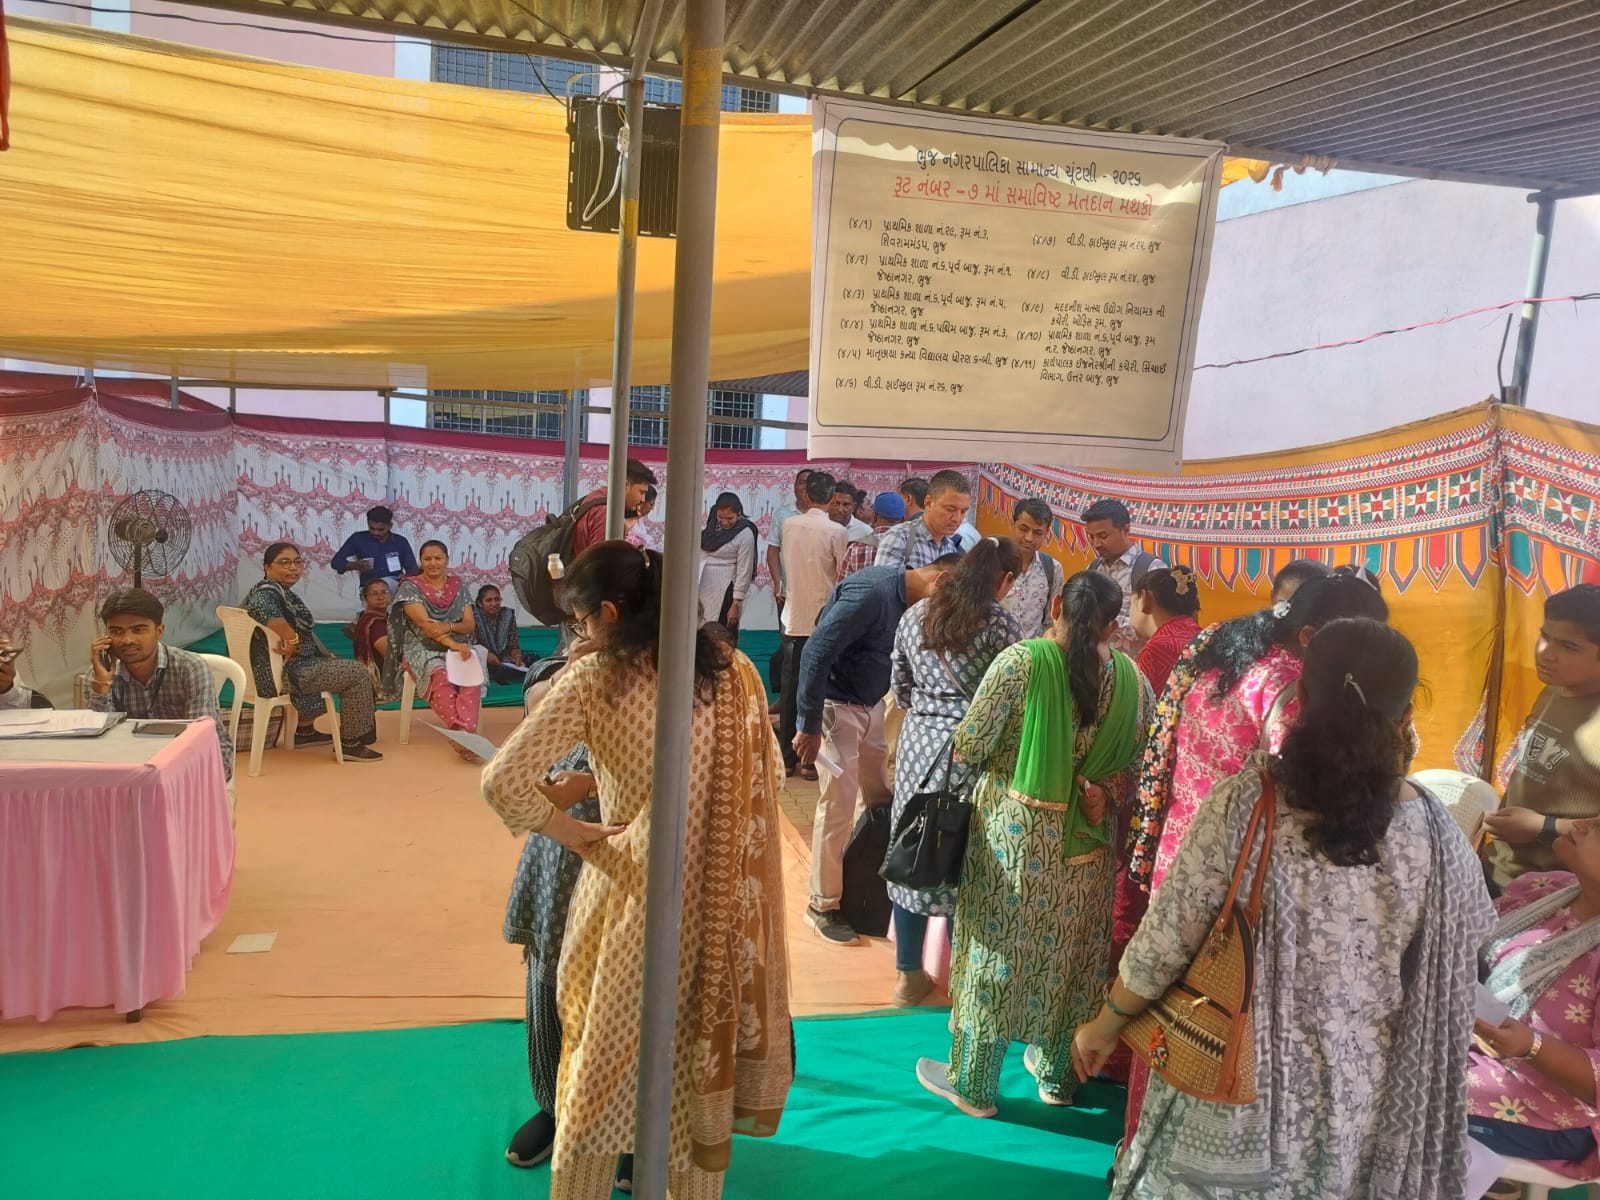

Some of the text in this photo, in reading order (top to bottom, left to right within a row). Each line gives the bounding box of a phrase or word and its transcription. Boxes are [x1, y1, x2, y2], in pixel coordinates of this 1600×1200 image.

[916, 150, 937, 167] ભુજ
[943, 151, 1010, 175] નગરપાલિકા
[1016, 162, 1059, 178] સામાન્ય
[1065, 162, 1096, 185] ચૂંટણી
[1113, 169, 1141, 186] ૨૦૨૬
[894, 175, 910, 195] રૂટ
[917, 173, 950, 198] નંબર
[985, 183, 999, 202] માં
[1006, 182, 1061, 208] સમાવિષ્ટ
[1068, 193, 1113, 213] મતદાન
[1120, 194, 1152, 216] મથકો
[849, 217, 872, 231] (૪/૧)
[884, 218, 911, 233] પ્રાથમિક
[915, 224, 933, 234] શાળા
[960, 228, 970, 240] રૂમ
[933, 242, 947, 254] ભુજ
[846, 253, 868, 266] (૪/૨)
[879, 253, 907, 268] પ્રાથમિક
[911, 259, 928, 268] શાળા
[984, 265, 994, 276] રૂમ
[918, 275, 932, 287] ભુજ
[843, 289, 864, 300] (૪/૩)
[873, 286, 899, 300] પ્રાથમિક
[904, 291, 920, 301] શાળા
[976, 298, 986, 308] રૂમ
[911, 307, 924, 318] ભુજ
[1126, 302, 1152, 316] નિયામક
[1156, 304, 1165, 317] ની
[840, 319, 863, 330] (૪/૪)
[869, 316, 895, 330] પ્રાથમિક
[900, 322, 916, 330] શાળા
[979, 327, 990, 339] રૂમ
[1110, 319, 1123, 331] ભુજ
[906, 335, 920, 347] ભુજ
[1049, 328, 1072, 340] પ્રાથમિક
[1075, 331, 1091, 341] શાળા
[1145, 337, 1155, 346] રૂમ
[900, 350, 916, 360] કન્યા
[919, 347, 948, 362] વિદ્યાલય
[952, 350, 970, 364] ધોરણ
[995, 356, 1008, 368] ભુજ
[1098, 347, 1111, 359] ભુજ
[1043, 357, 1072, 368] કાર્યપાલક
[916, 381, 925, 392] રૂમ
[950, 383, 964, 395] ભુજ
[1106, 376, 1119, 387] ભુજ
